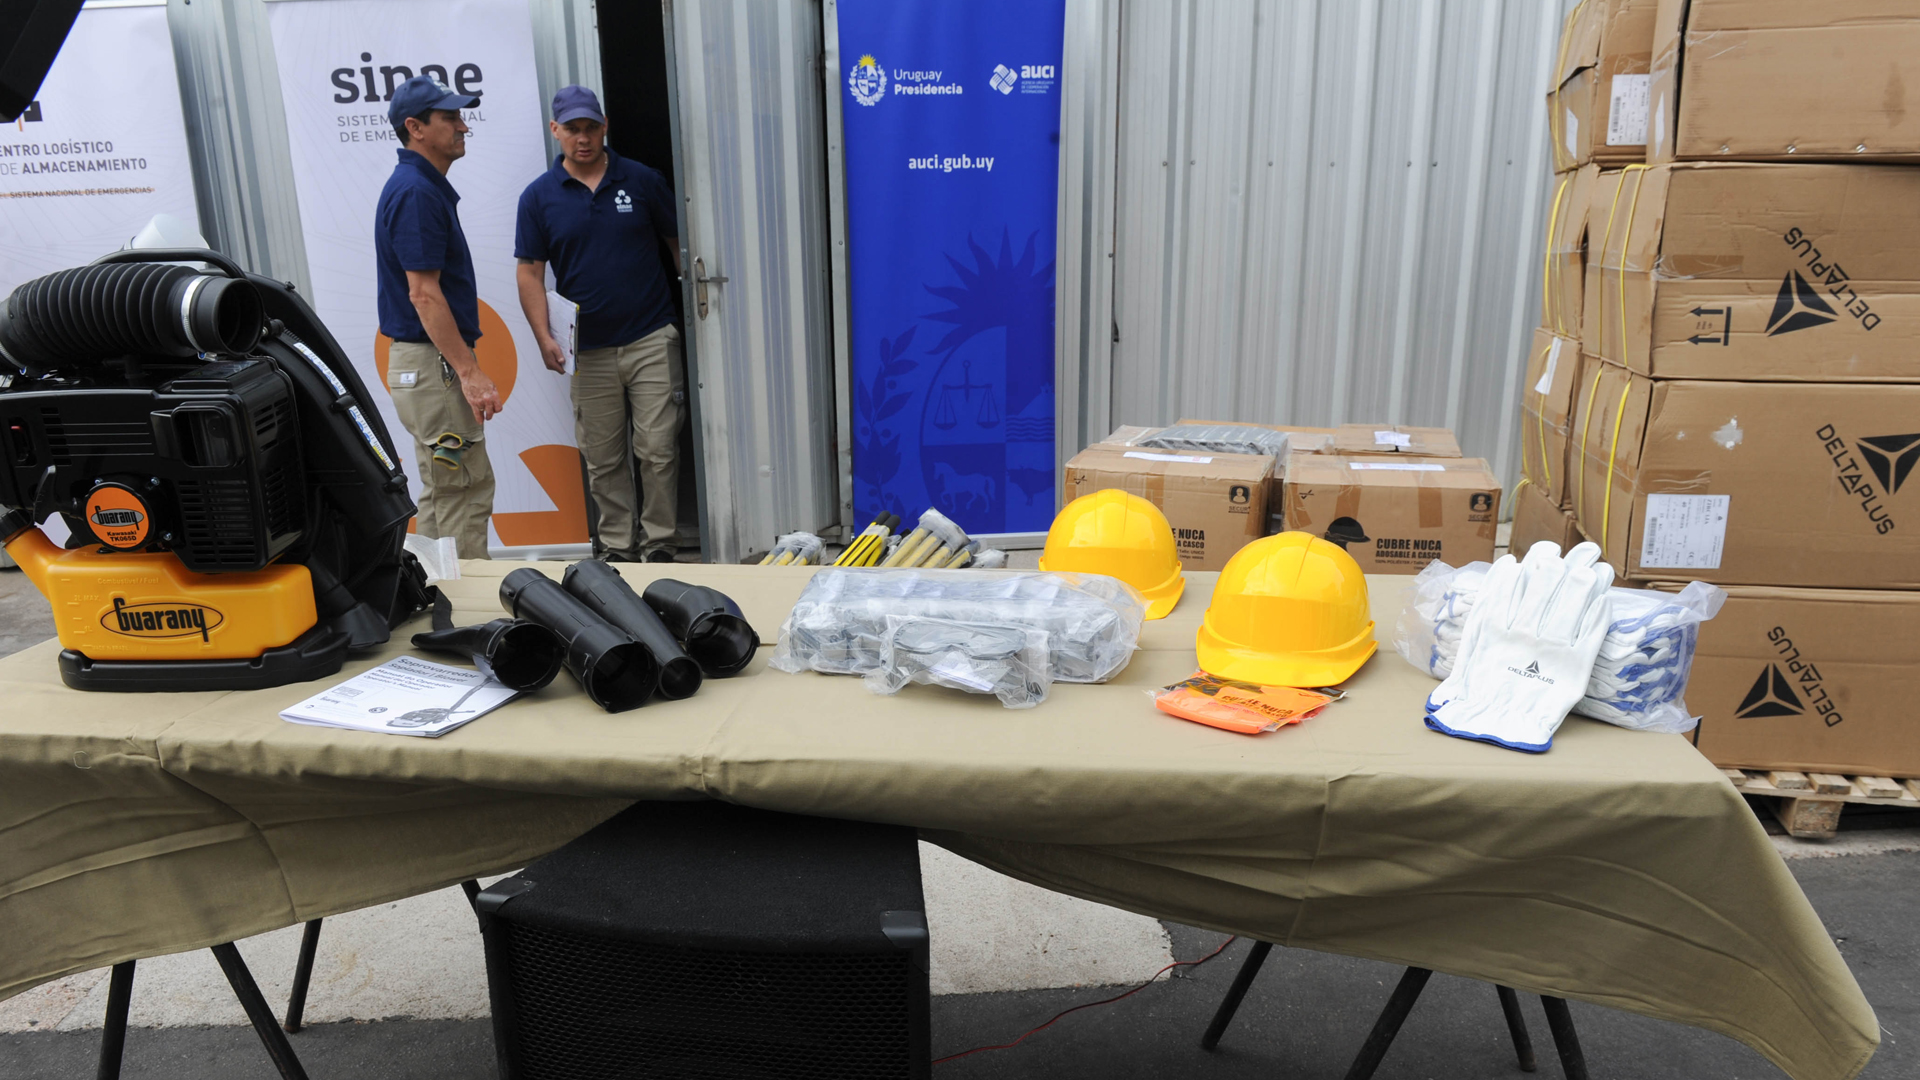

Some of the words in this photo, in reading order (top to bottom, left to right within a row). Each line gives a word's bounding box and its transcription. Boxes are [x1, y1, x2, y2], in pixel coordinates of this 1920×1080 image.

[894, 69, 942, 82] Uruguay
[1021, 65, 1055, 79] auci
[894, 83, 963, 95] Presidencia
[337, 114, 390, 127] SISTEM
[340, 131, 361, 143] DE
[0, 144, 40, 157] ENTRO
[44, 138, 113, 156] LOGÍSTICO
[0, 162, 18, 176] DE
[22, 158, 147, 175] ALMACENAMIENTO
[908, 154, 994, 173] auci.gub.uy
[10, 190, 44, 199] SISTEMA
[45, 189, 83, 198] NACIONAL
[84, 188, 96, 196] DE
[97, 186, 153, 196] EMERGENCIAS
[1783, 227, 1881, 331] DELTAPLUS
[1815, 423, 1895, 536] DELTAPLUS
[95, 505, 139, 531] Guarany
[1178, 528, 1205, 540] NUCA
[1182, 540, 1205, 549] CASCO
[1376, 538, 1411, 550] CUBRE
[1413, 539, 1442, 550] NUCA
[1375, 550, 1411, 559] ADOSABLE
[1411, 551, 1417, 559] A
[1417, 551, 1442, 559] CASCO
[113, 597, 209, 643] Guarany
[388, 663, 430, 676] Soplador
[398, 658, 479, 679] Soprovarredor
[1507, 666, 1555, 685] DELTAPLUS
[1767, 626, 1844, 728] DELTAPLUS
[1222, 695, 1261, 705] CURE
